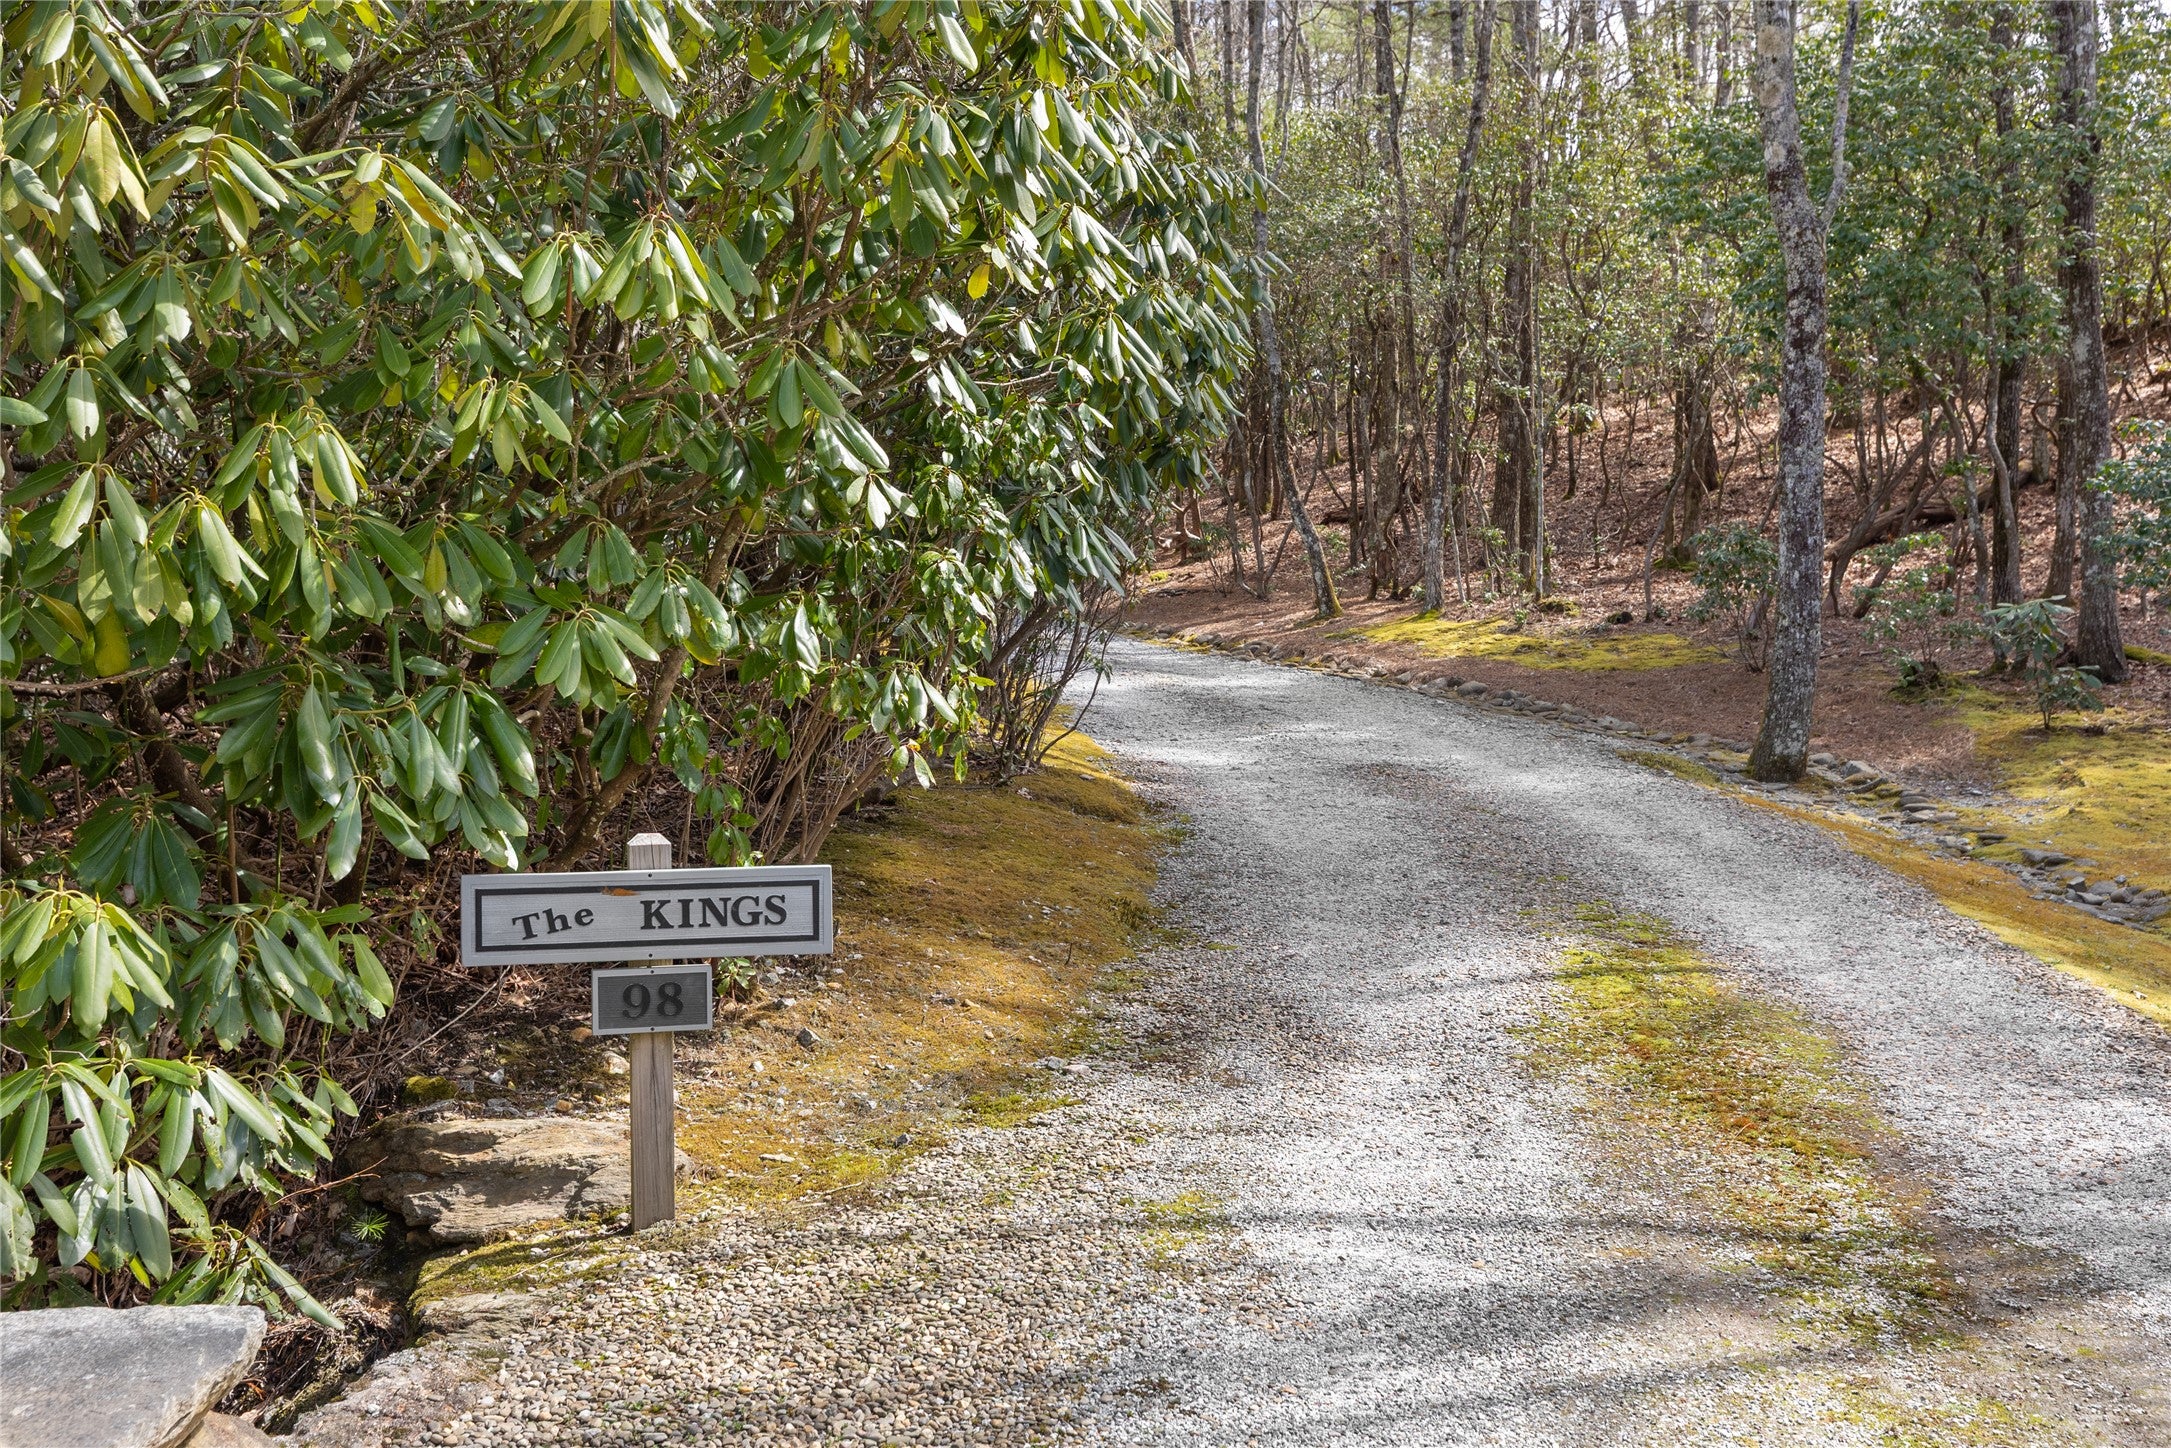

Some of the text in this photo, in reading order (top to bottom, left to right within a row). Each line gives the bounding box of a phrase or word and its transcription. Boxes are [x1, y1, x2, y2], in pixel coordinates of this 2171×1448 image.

[512, 894, 788, 940] The KINGS
[622, 981, 684, 1019] 98
